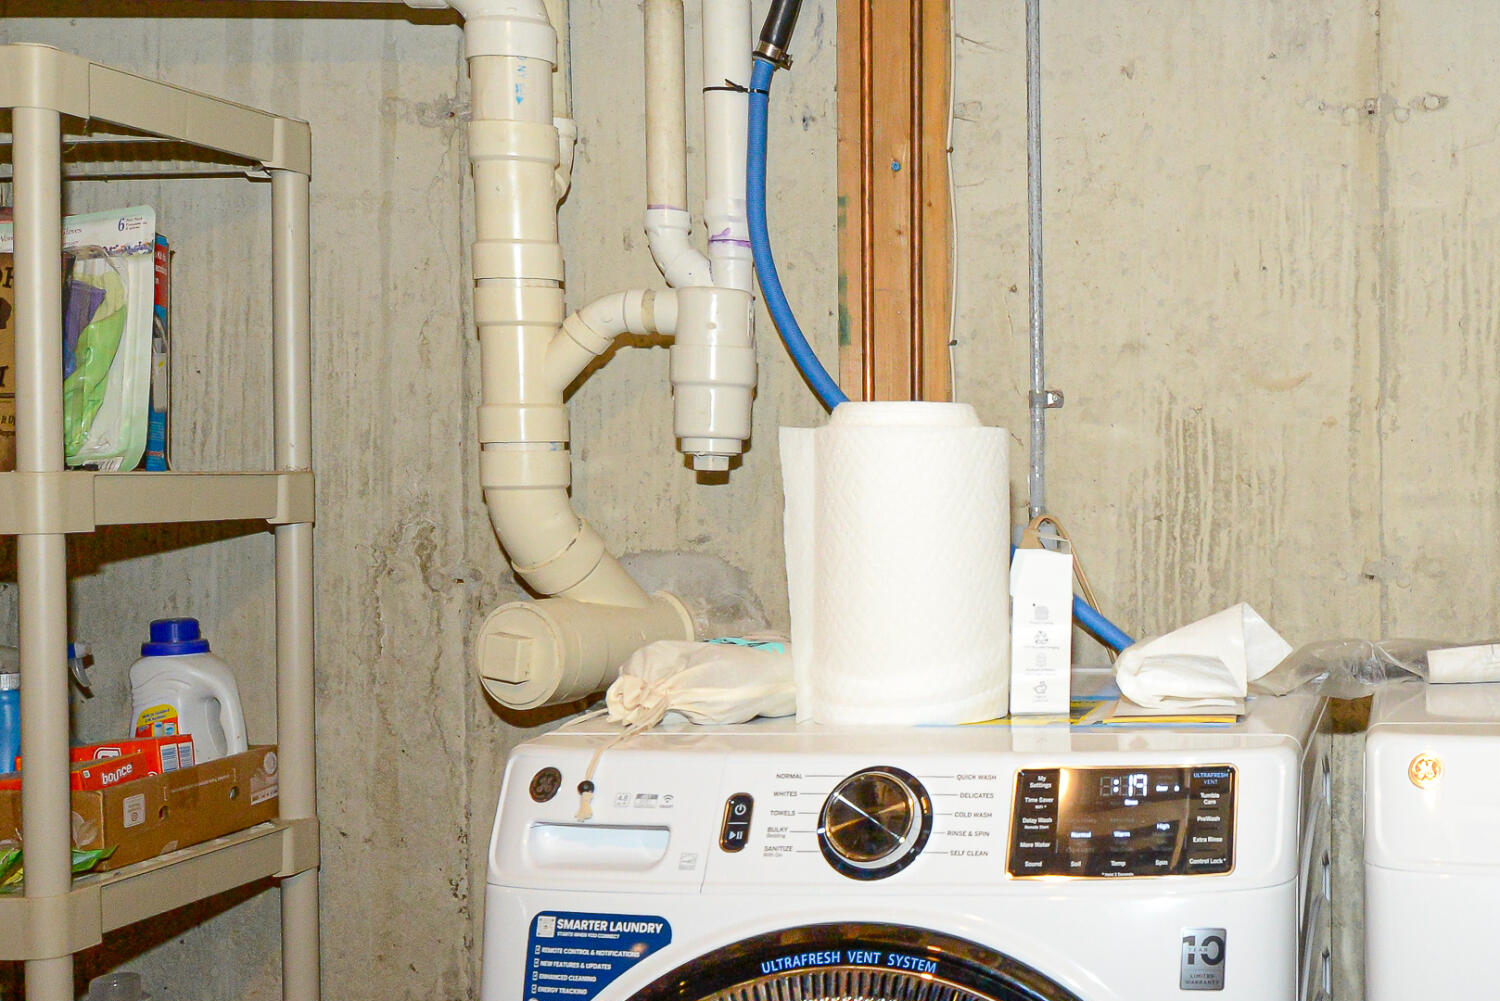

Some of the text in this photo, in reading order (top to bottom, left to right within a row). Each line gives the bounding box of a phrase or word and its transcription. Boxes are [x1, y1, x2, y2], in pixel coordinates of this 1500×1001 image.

[117, 217, 125, 232] 6
[101, 763, 133, 786] bounce
[773, 790, 798, 798] WHITES
[557, 919, 664, 934] SMARTER LAUNDRY
[541, 946, 563, 955] REMOTE
[563, 948, 590, 956] CONTROL
[596, 950, 641, 958] NOTIFICATIONS
[1183, 935, 1225, 966] 10
[553, 960, 580, 969] FEATURES
[585, 962, 612, 970] UPDATES
[761, 951, 937, 974] ULTRAFRESH VENT SYSTEM
[539, 973, 597, 982] ENHANCED CLEANING
[537, 986, 588, 995] ENERGY TRACKING
